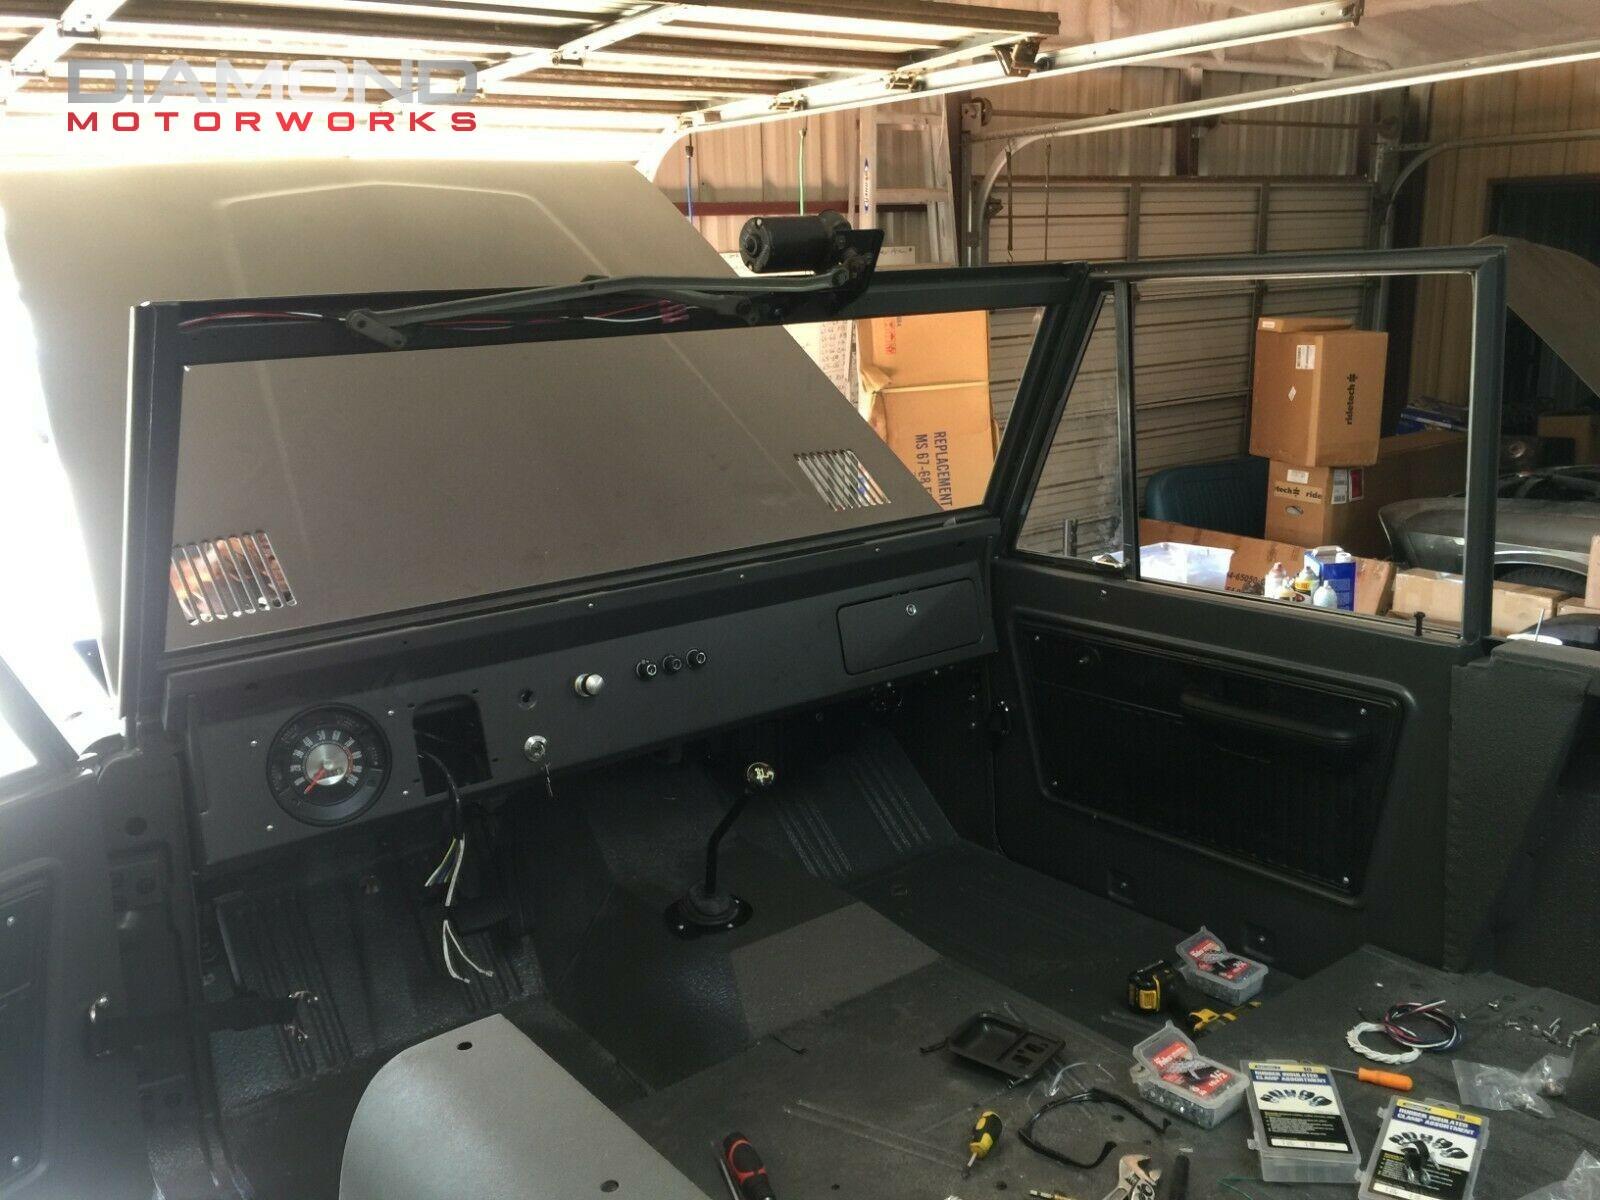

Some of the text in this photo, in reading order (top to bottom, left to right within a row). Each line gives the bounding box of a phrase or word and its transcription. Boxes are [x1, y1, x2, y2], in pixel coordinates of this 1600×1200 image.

[1345, 383, 1356, 425] ridetech
[915, 434, 928, 450] MS
[934, 431, 953, 506] REPLACEMENT
